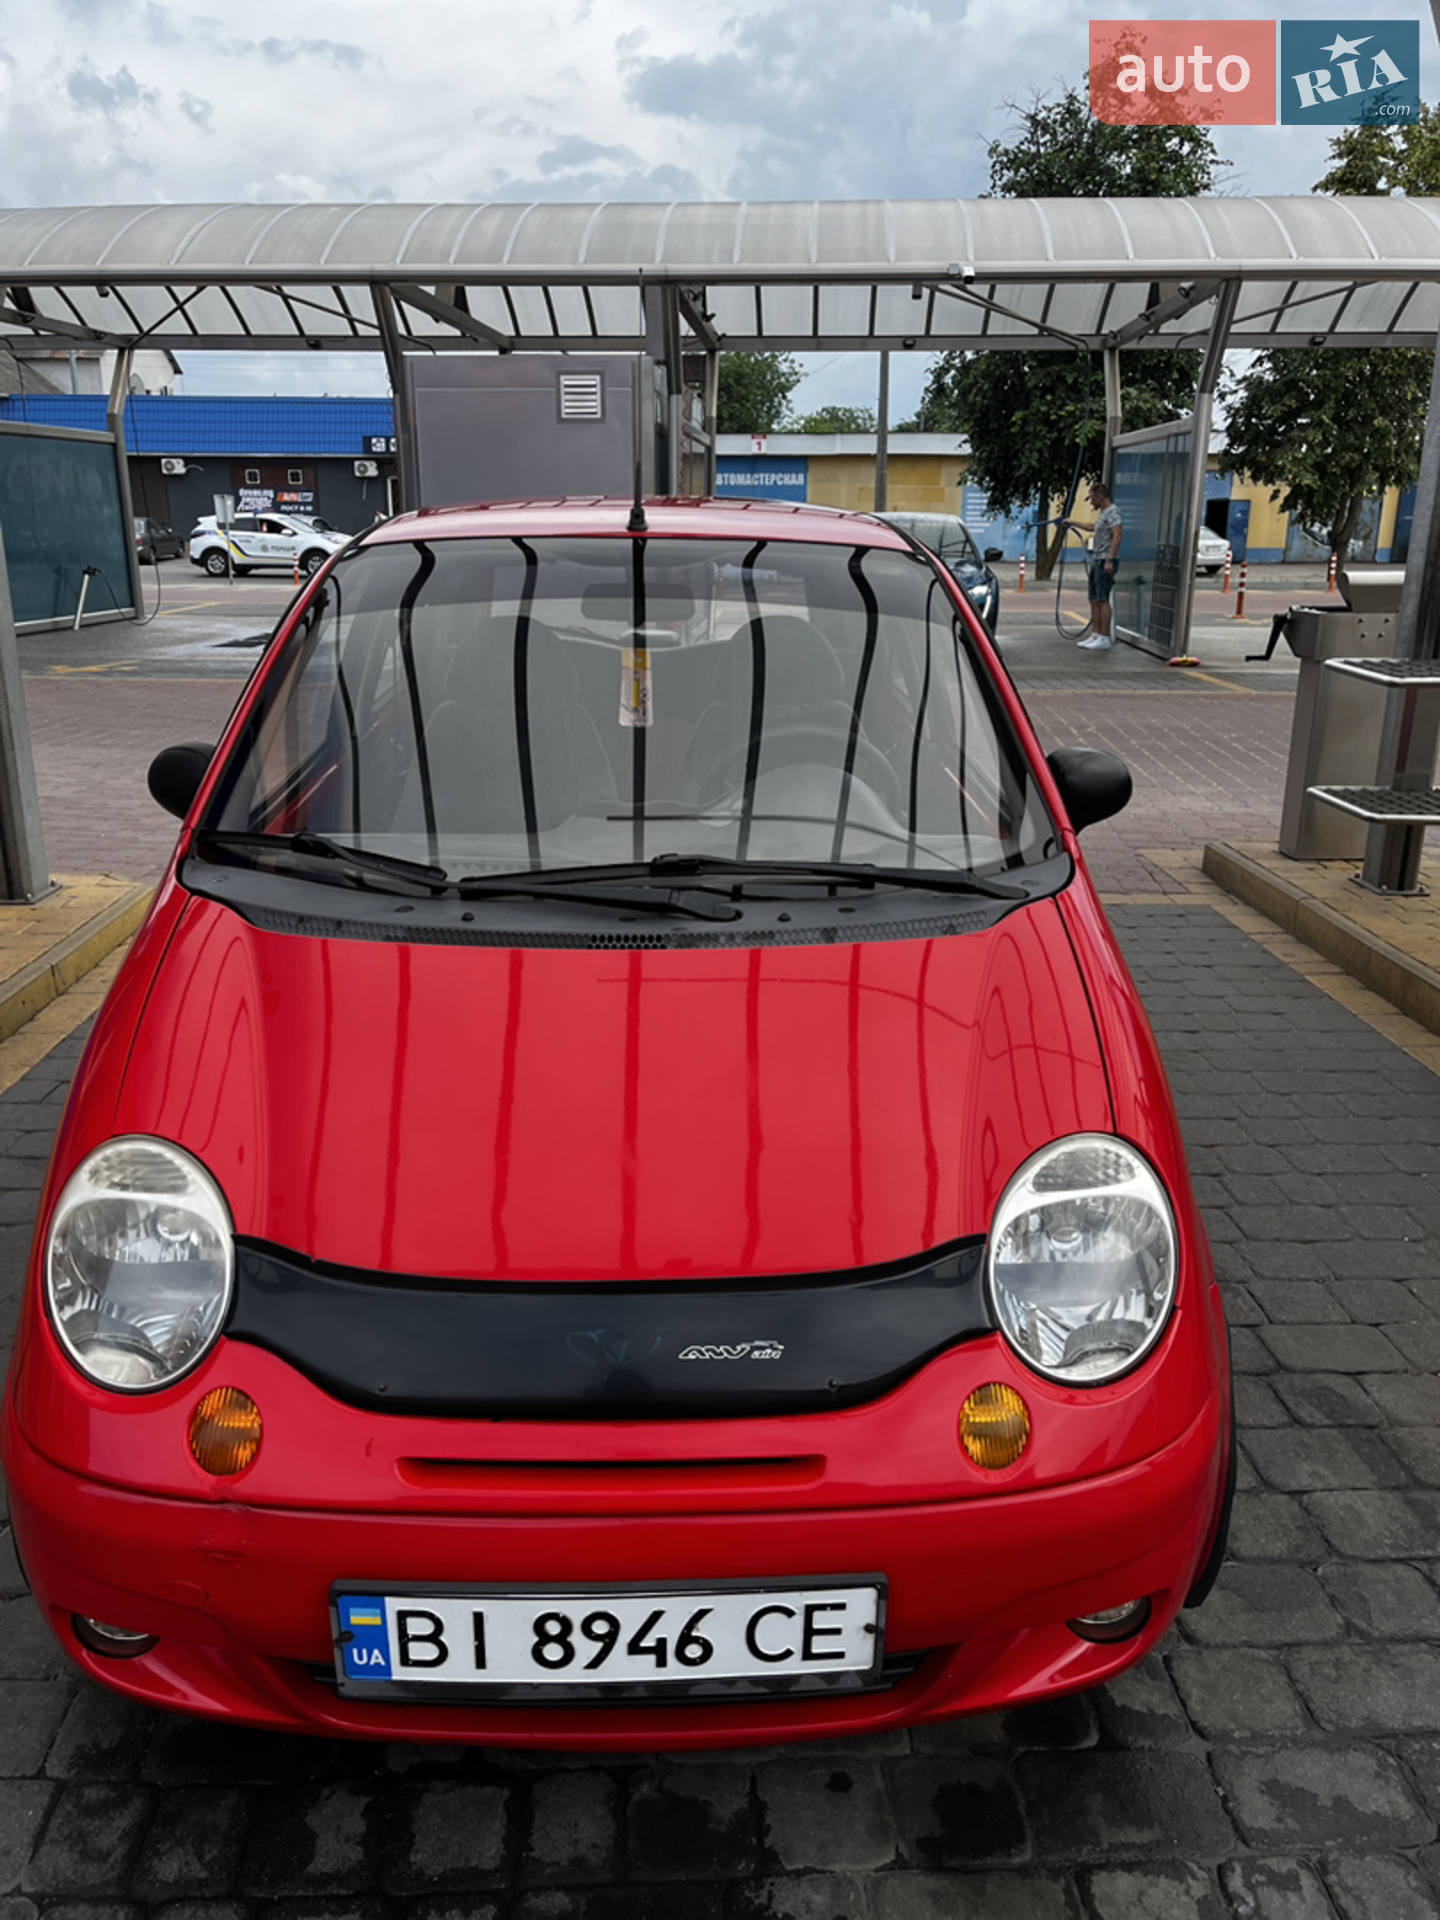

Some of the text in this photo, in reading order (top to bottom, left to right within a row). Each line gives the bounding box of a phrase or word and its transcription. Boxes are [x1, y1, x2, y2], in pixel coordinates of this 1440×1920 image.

[754, 440, 763, 452] 1
[715, 472, 805, 486] ВТОМАСТЕРСКАЯ
[396, 1602, 847, 1670] BI 8946 CE
[353, 1648, 386, 1668] UA
